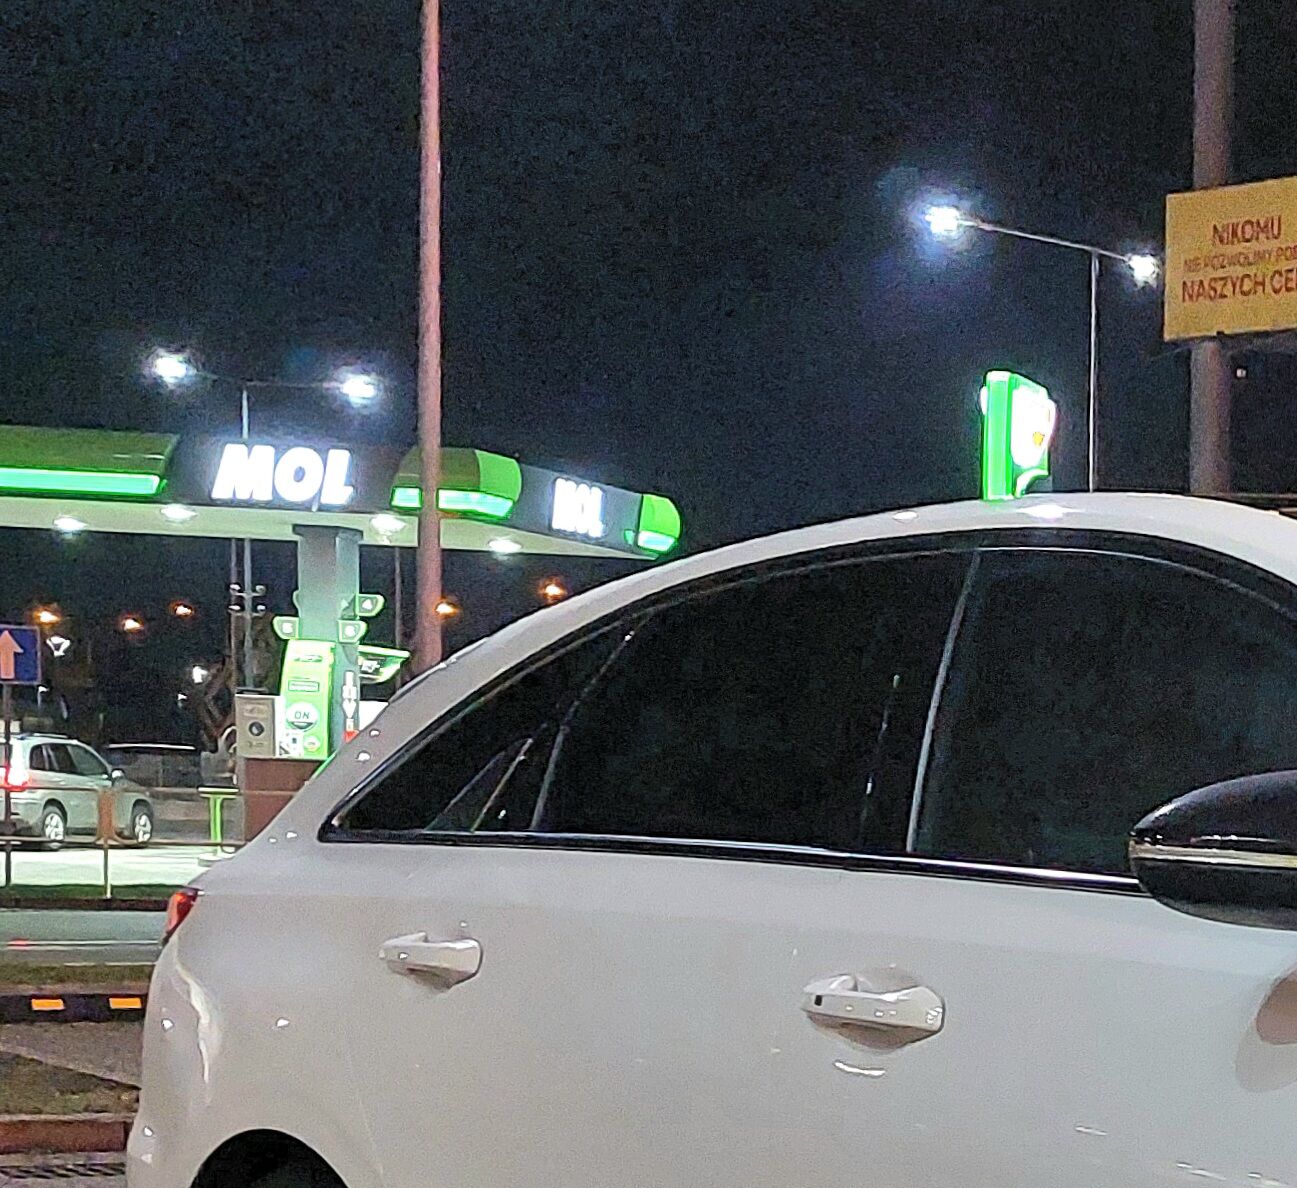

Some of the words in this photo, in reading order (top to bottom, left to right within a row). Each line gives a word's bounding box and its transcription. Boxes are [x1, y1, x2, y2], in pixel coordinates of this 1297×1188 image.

[1211, 214, 1283, 246] NIKOMU
[1181, 272, 1267, 304] NASZYCH
[210, 442, 355, 506] MOL
